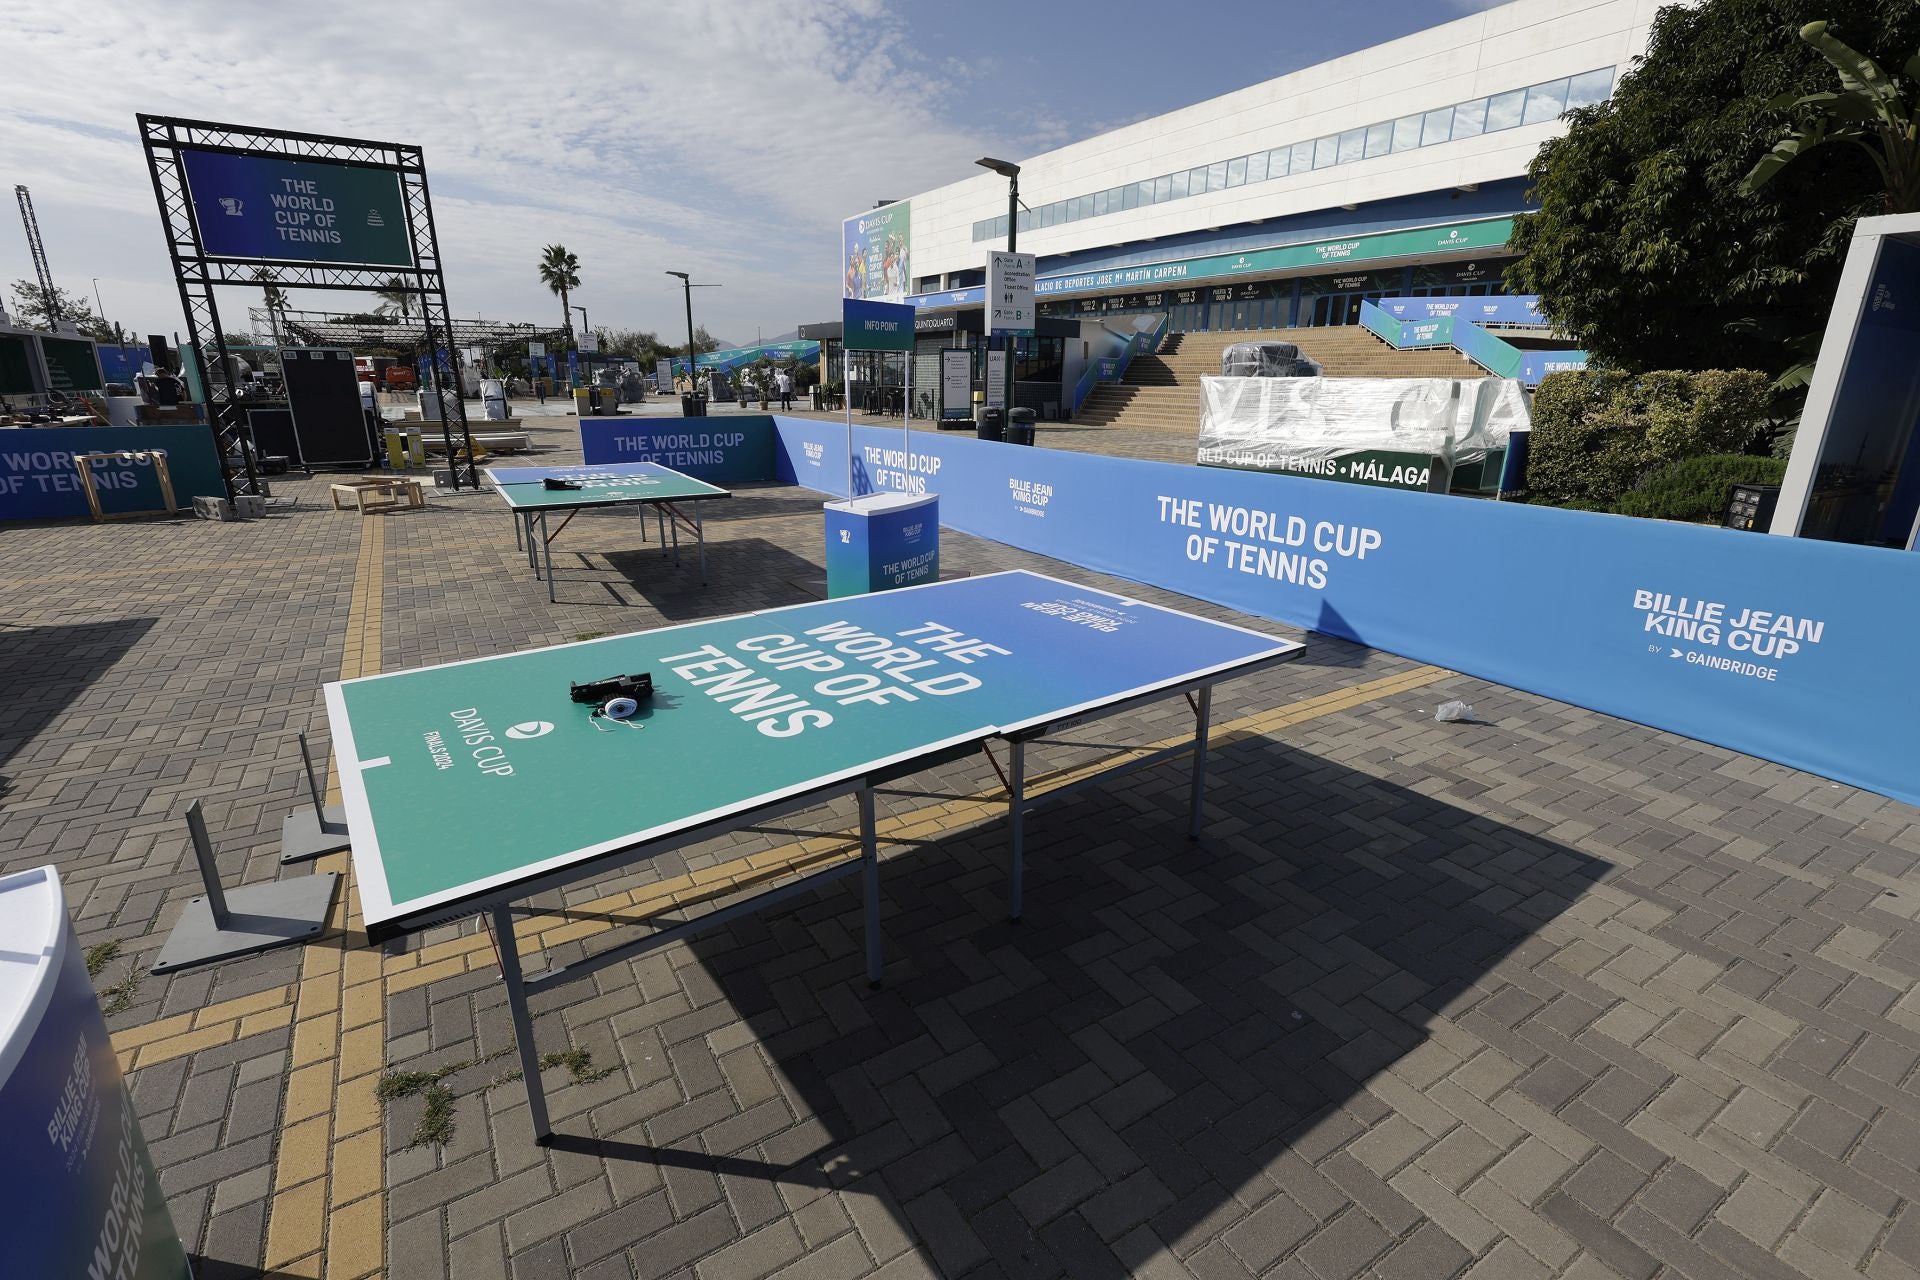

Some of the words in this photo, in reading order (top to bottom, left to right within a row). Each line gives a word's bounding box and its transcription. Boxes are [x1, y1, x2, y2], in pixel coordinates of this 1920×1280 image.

[281, 178, 318, 195] THE
[270, 194, 334, 212] WORLD
[275, 210, 310, 226] CUP
[315, 213, 336, 228] OF
[865, 217, 880, 229] DAVIS
[881, 214, 893, 224] CUP
[276, 227, 342, 244] TENNIS
[1327, 243, 1347, 251] WORLD
[1330, 250, 1351, 258] TENNIS
[1003, 270, 1031, 278] Accreditation
[1016, 258, 1023, 269] A
[1035, 282, 1054, 292] ALACIO
[1055, 280, 1062, 289] DE
[1065, 276, 1094, 288] DEPORTES
[1096, 274, 1112, 285] JOSE
[1125, 268, 1151, 282] MARTÍN
[1154, 265, 1187, 279] CARPENA
[1119, 297, 1124, 308] 2
[1156, 294, 1162, 305] 3
[1190, 291, 1196, 302] 3
[1226, 288, 1233, 300] 3
[1016, 310, 1022, 320] B
[1091, 300, 1096, 310] 2
[864, 320, 880, 331] INFO
[880, 321, 898, 332] POINT
[914, 318, 954, 330] QUINTOQUARTO
[1544, 362, 1555, 371] THE
[1556, 362, 1577, 371] WORLD
[1577, 362, 1588, 370] CU
[613, 436, 649, 452] THE
[651, 433, 710, 450] WORLD
[713, 432, 745, 447] CUP
[1, 450, 109, 471] WORD
[640, 452, 662, 463] OF
[665, 450, 724, 466] TENNIS
[864, 446, 882, 465] THE
[883, 449, 917, 471] WORLD
[919, 454, 941, 475] CUP
[1226, 450, 1254, 466] CUP
[1257, 453, 1277, 468] OF
[1280, 455, 1337, 476] TENNIS
[1350, 459, 1430, 486] MÁLAGA
[32, 471, 138, 492] TENNIS
[876, 469, 888, 486] OF
[890, 471, 926, 494] TENNIS
[1009, 478, 1031, 493] BILLIE
[1032, 482, 1053, 497] JEAN
[1012, 489, 1031, 504] KING
[1032, 493, 1049, 507] CUP
[1157, 495, 1203, 528] THE
[1208, 503, 1307, 547] WORLD
[1313, 521, 1382, 560] CUP
[883, 562, 900, 576] THE
[900, 555, 925, 571] WORLD
[924, 550, 935, 563] CUP
[1186, 534, 1219, 564] OF
[1224, 540, 1329, 590] TENNIS
[895, 574, 905, 585] OF
[906, 564, 929, 581] TENNIS
[1633, 589, 1726, 625] BILLIE
[1729, 608, 1825, 643] JEAN
[896, 621, 1014, 665] THE
[1644, 612, 1721, 646] KING
[1727, 630, 1800, 659] CUP
[803, 620, 983, 696] WORLD
[1648, 644, 1662, 654] BY
[1686, 651, 1779, 682] GAINBRIDGE
[736, 634, 845, 672] CUP
[813, 673, 920, 706] OF
[658, 644, 834, 738] TENNIS
[450, 707, 495, 745] DAVIS
[422, 731, 447, 754] FINALS
[432, 752, 455, 770] 2024
[472, 746, 514, 776] CUP
[47, 1074, 76, 1145] BILLIE
[73, 1031, 88, 1084] JEAN
[59, 1094, 83, 1152] KING
[78, 1057, 91, 1099] CUP
[87, 1140, 131, 1280] WORLD
[115, 1152, 145, 1280] TENNIS
